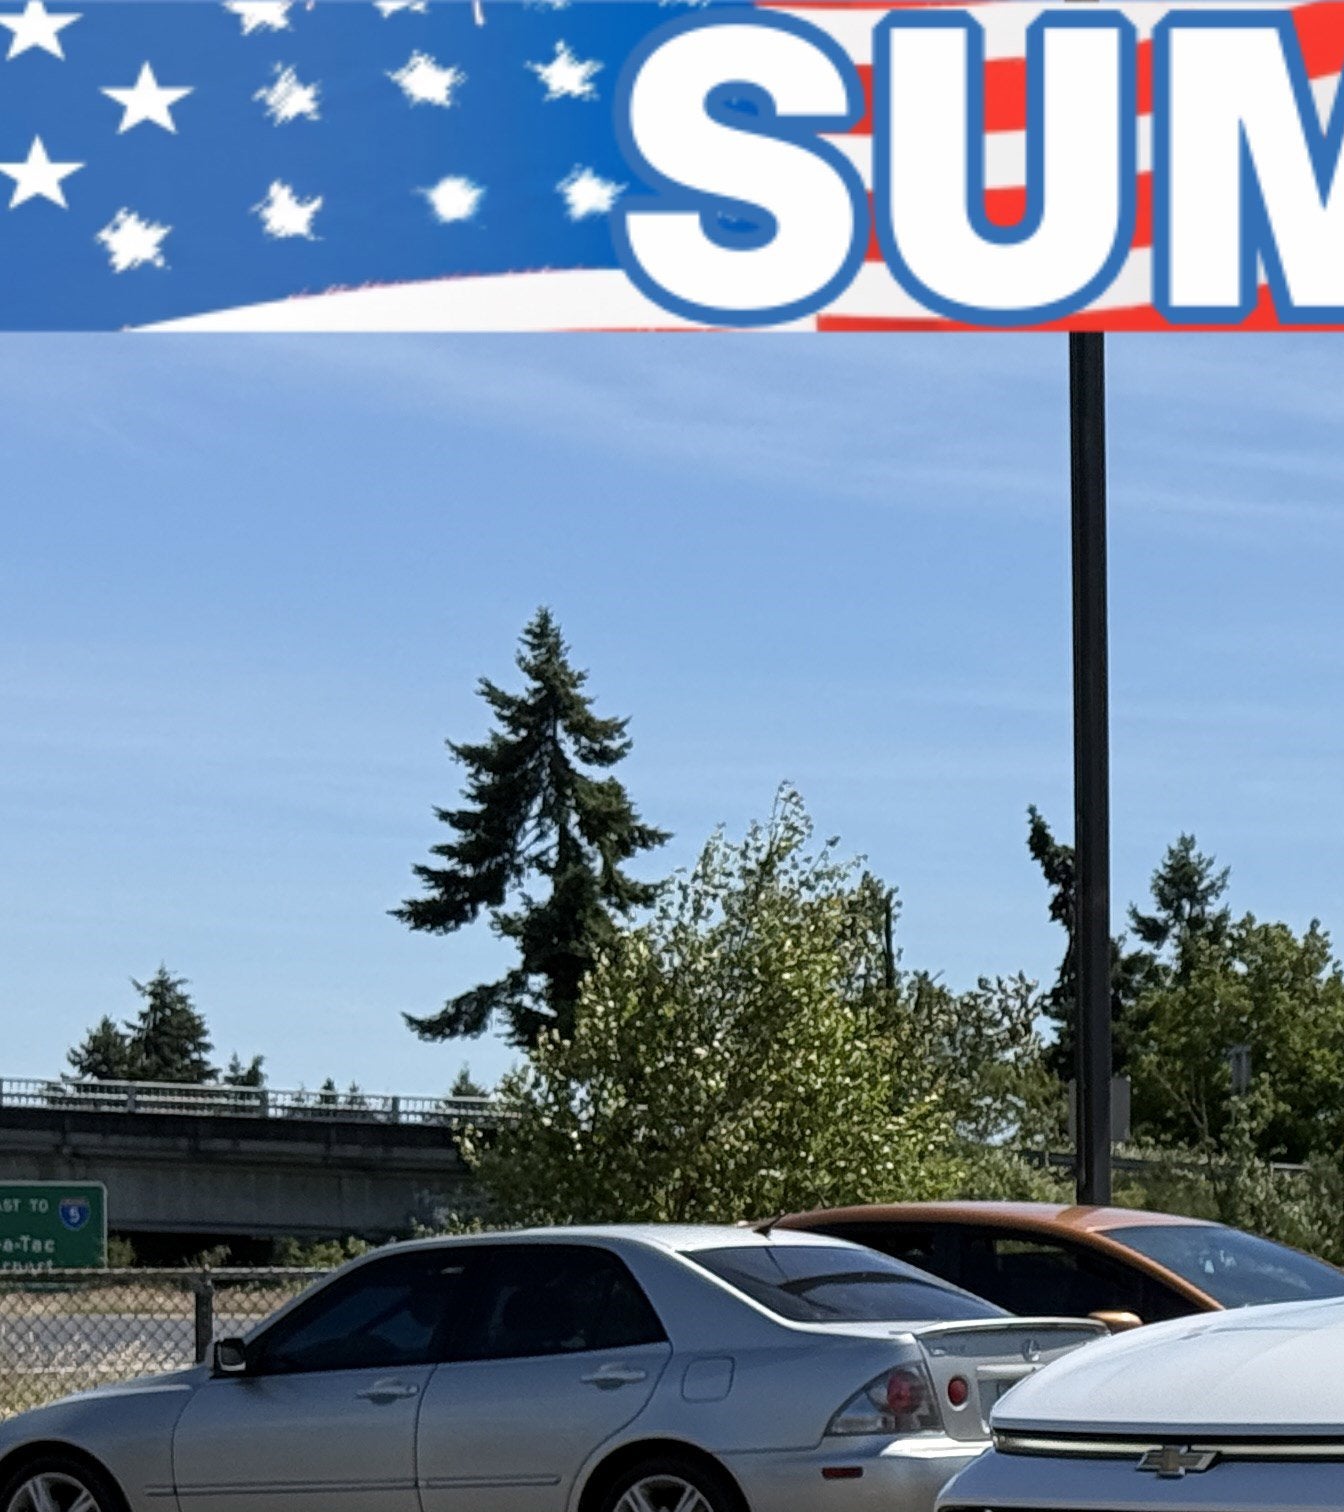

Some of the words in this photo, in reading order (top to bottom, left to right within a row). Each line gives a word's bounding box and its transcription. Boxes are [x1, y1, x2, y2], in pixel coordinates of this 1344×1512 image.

[0, 1198, 21, 1213] ST
[30, 1198, 49, 1214] TO
[0, 1235, 55, 1253] a-Tac
